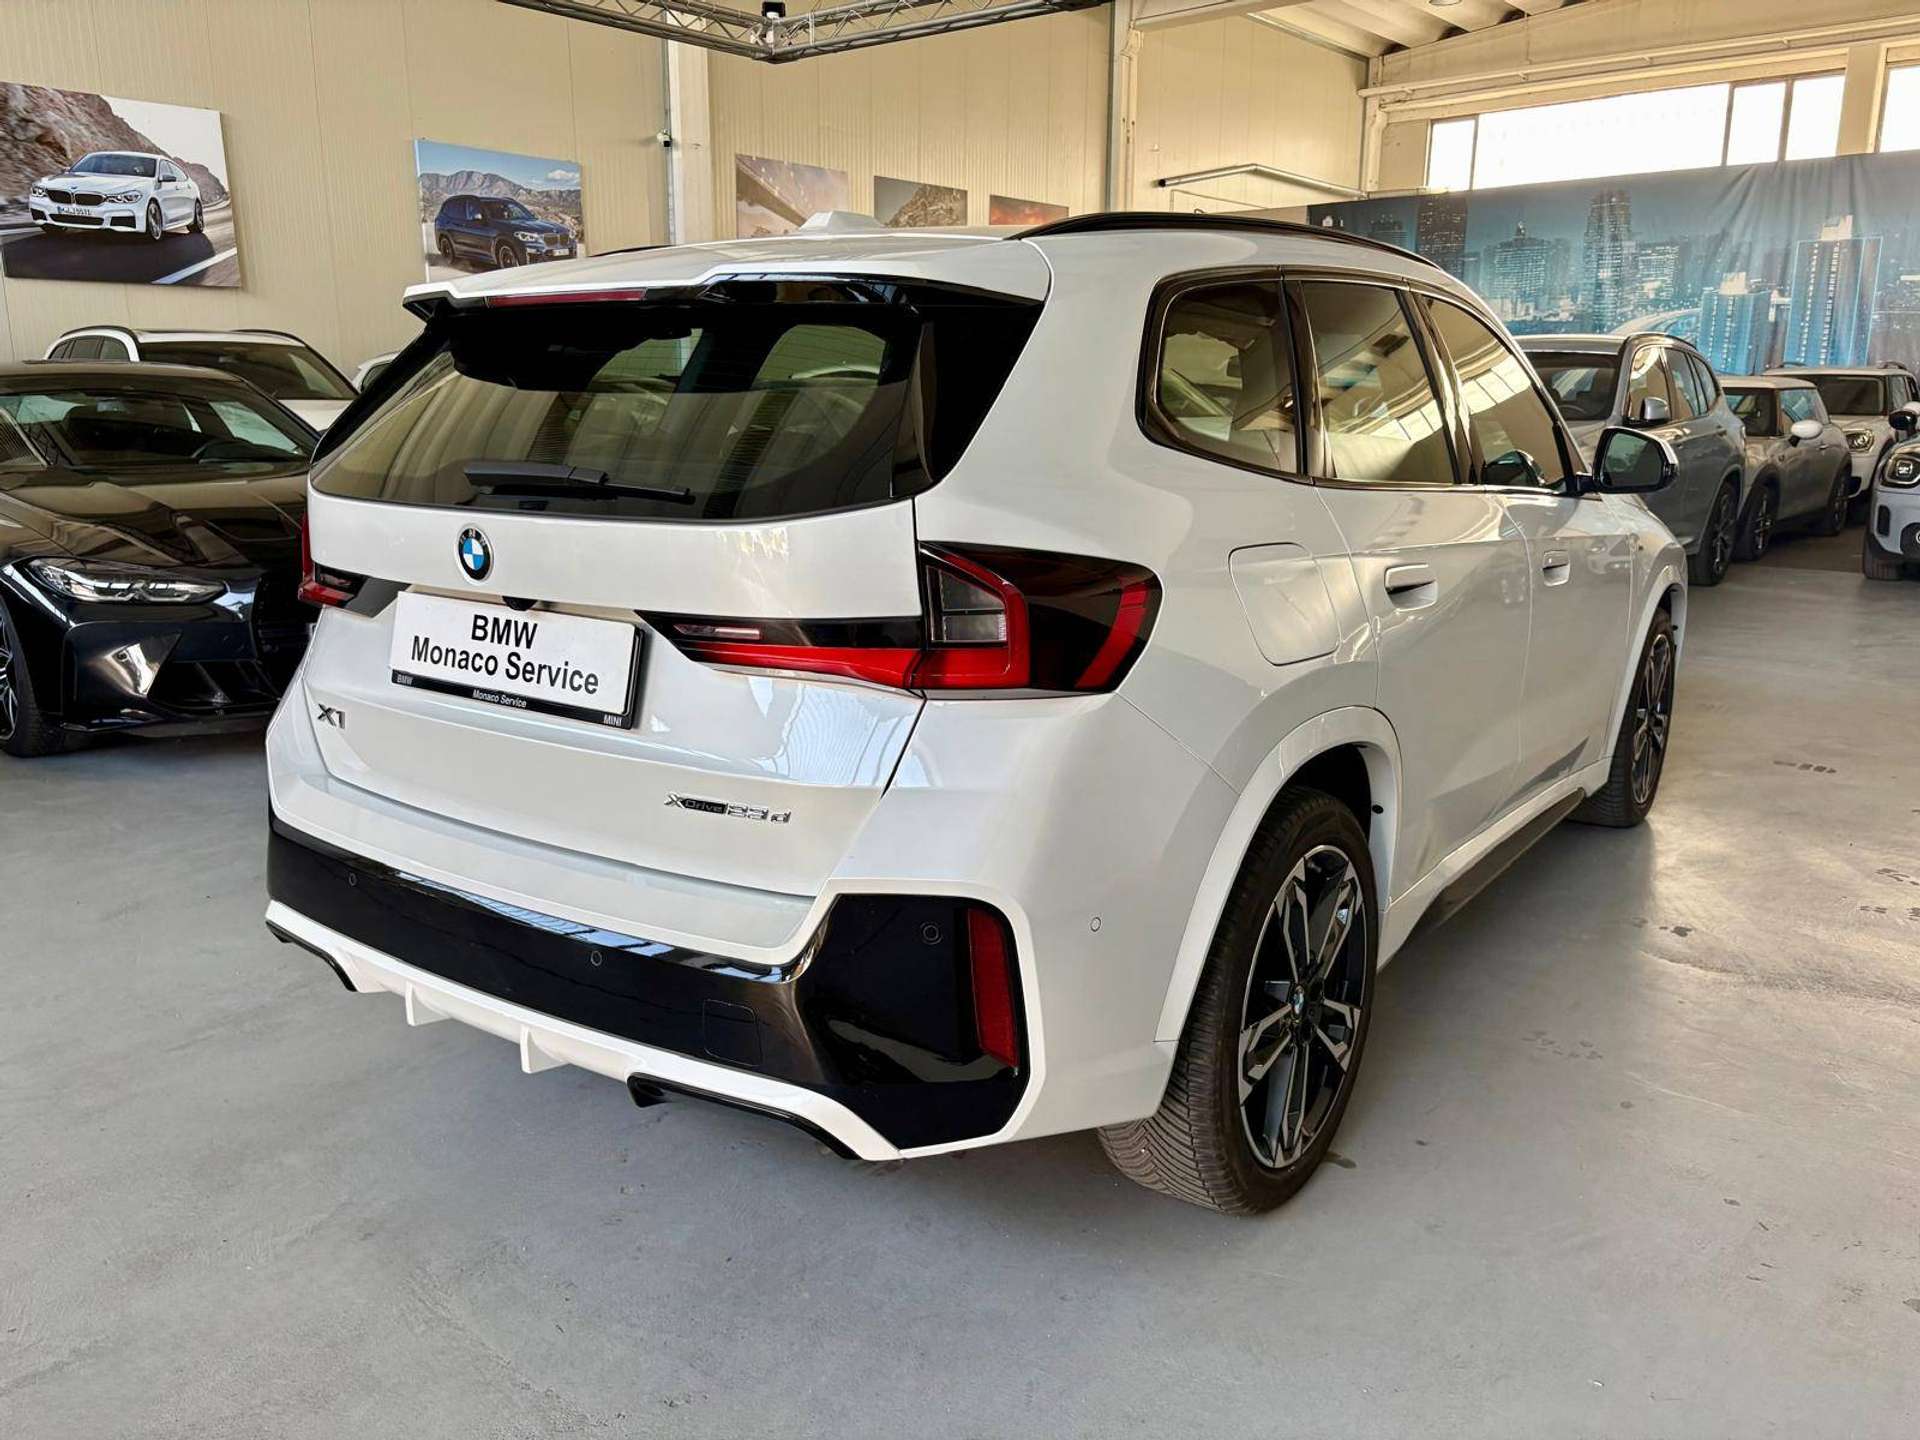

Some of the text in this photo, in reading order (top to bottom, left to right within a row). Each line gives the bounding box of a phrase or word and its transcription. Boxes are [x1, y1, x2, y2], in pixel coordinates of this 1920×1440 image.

[471, 614, 538, 649] BMW
[411, 635, 599, 695] Monaco Service
[397, 674, 414, 686] BMW
[472, 689, 527, 708] Monaco Service
[317, 703, 346, 729] X1
